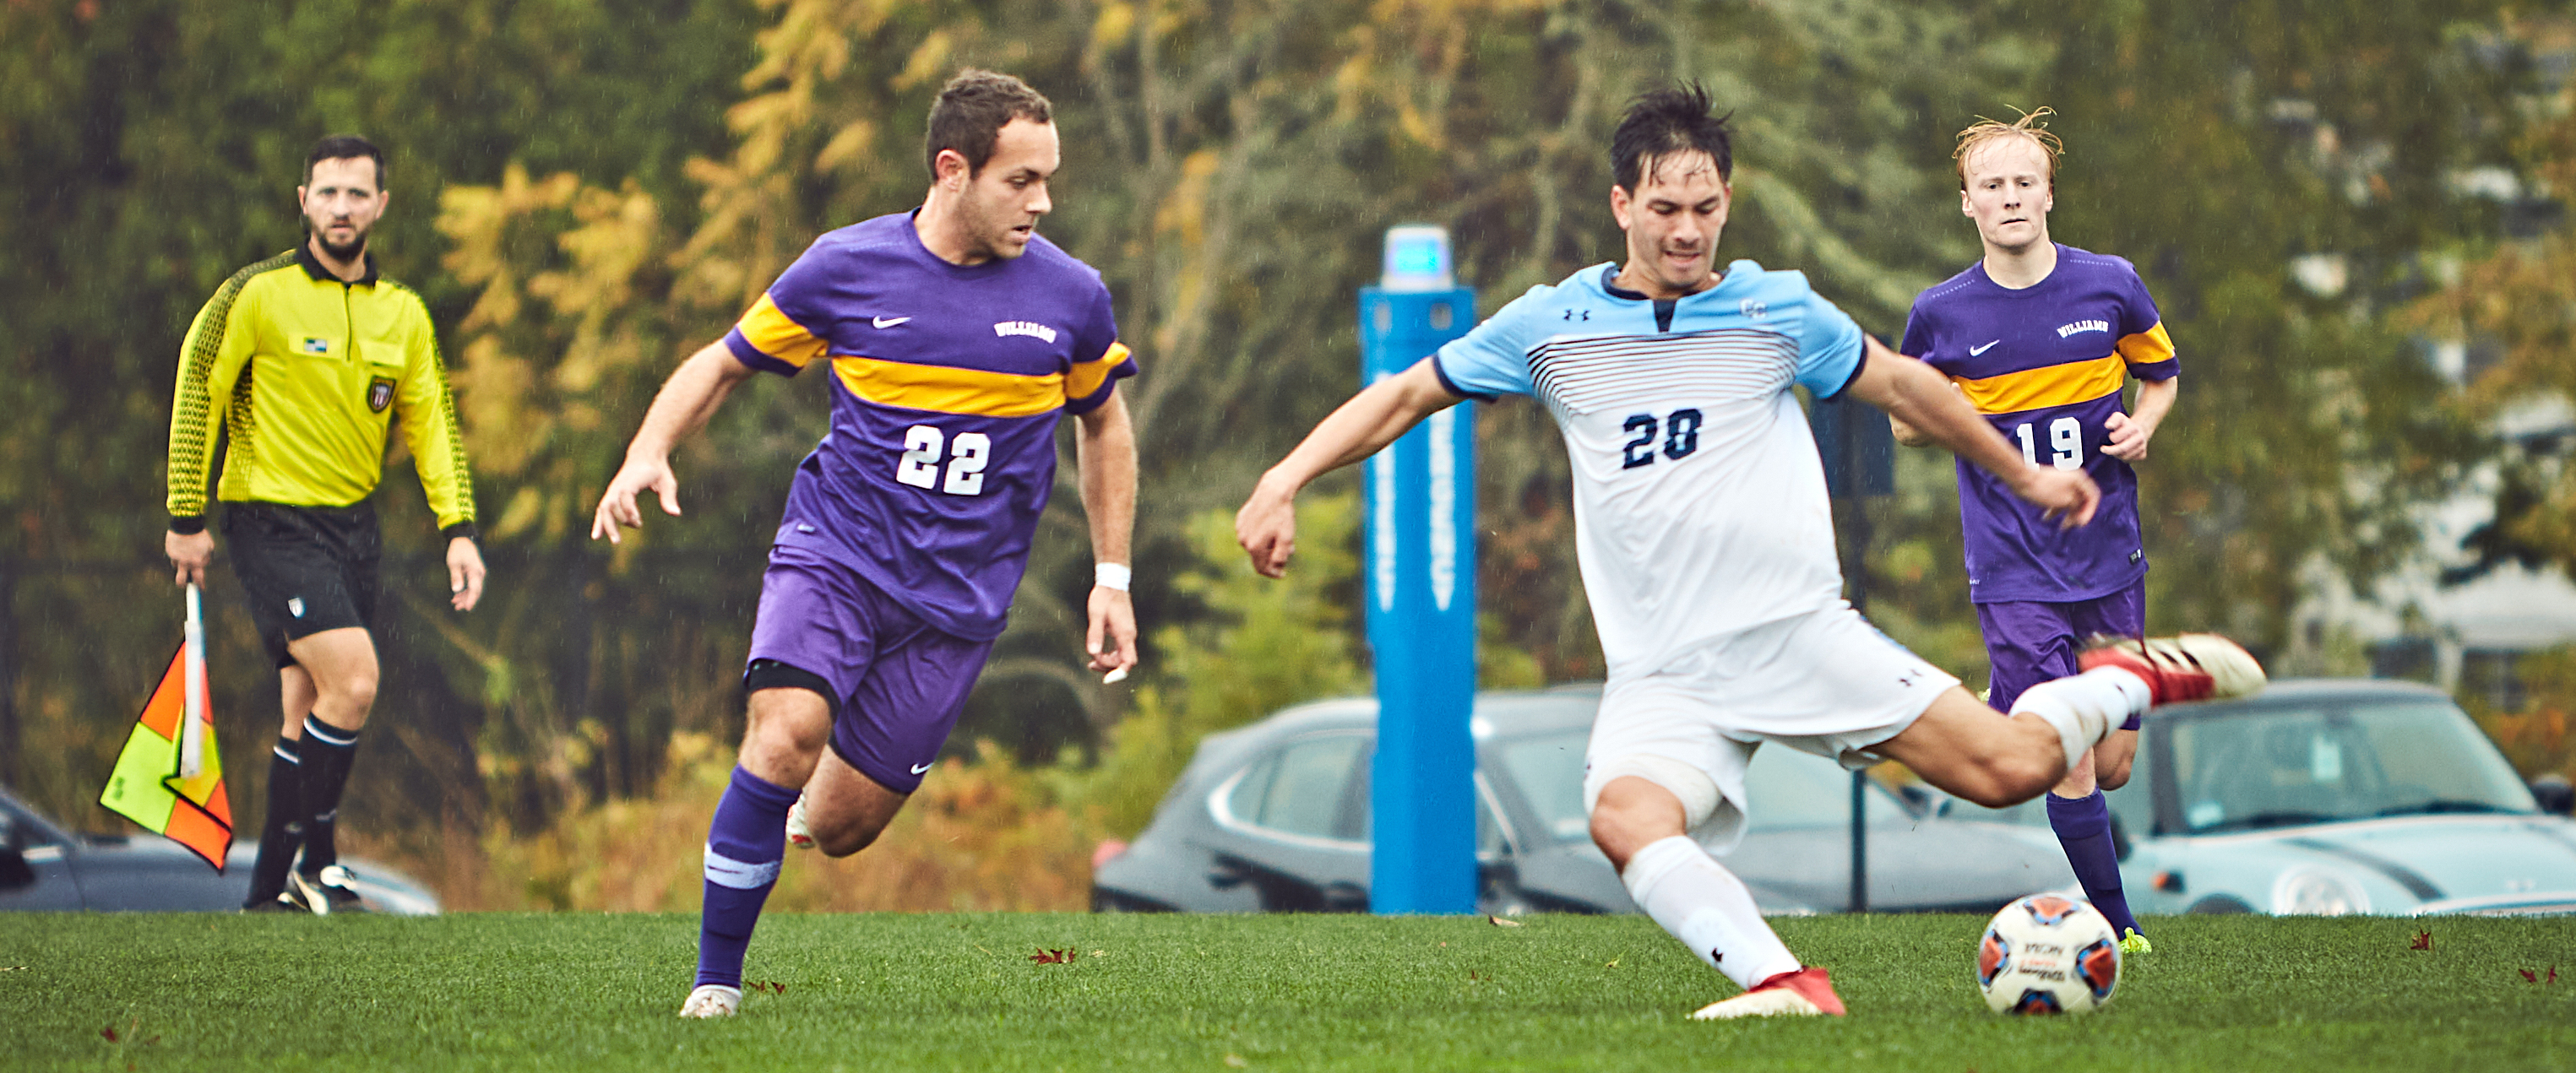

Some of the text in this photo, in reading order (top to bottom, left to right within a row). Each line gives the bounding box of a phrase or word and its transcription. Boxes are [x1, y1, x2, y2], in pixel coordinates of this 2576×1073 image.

[993, 321, 1057, 344] WILLIAMS
[2057, 320, 2109, 338] WILLIAMS
[896, 425, 991, 496] 22
[2017, 417, 2084, 471] 19
